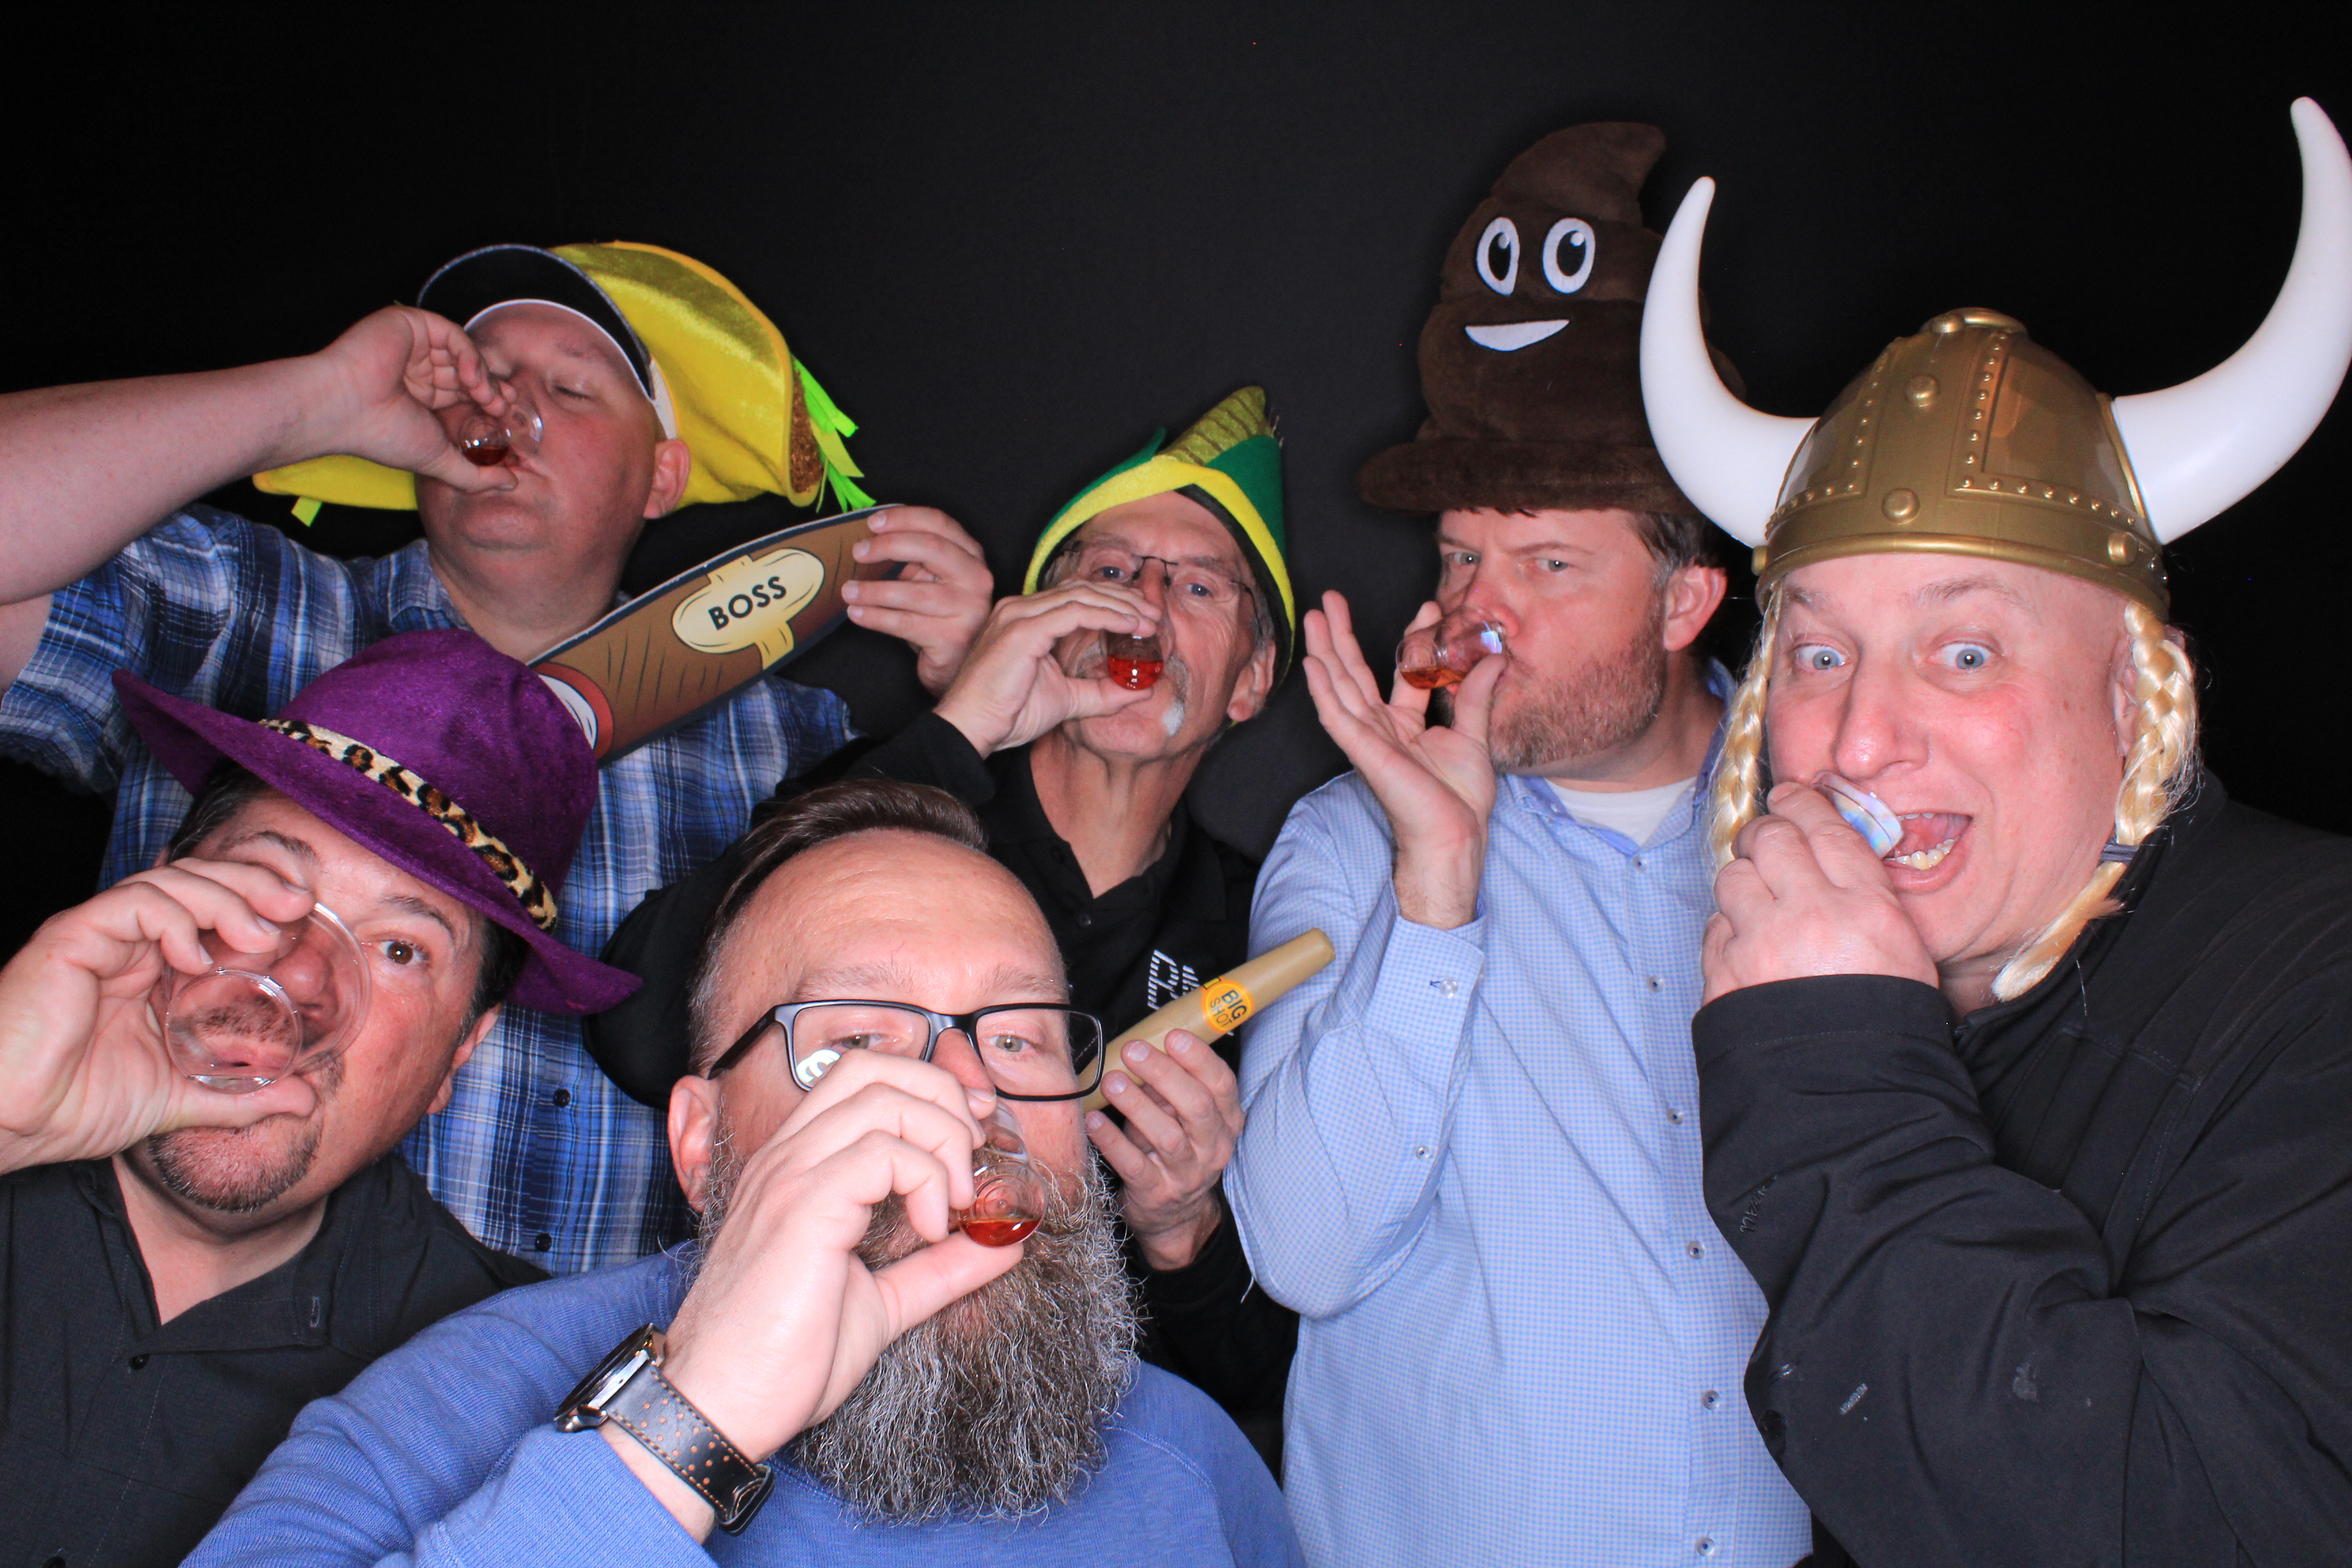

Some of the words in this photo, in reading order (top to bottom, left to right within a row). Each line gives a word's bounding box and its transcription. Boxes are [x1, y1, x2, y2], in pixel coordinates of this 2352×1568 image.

[707, 576, 787, 630] BOSS
[1210, 997, 1232, 1027] SHOT
[1222, 990, 1247, 1021] BIG
